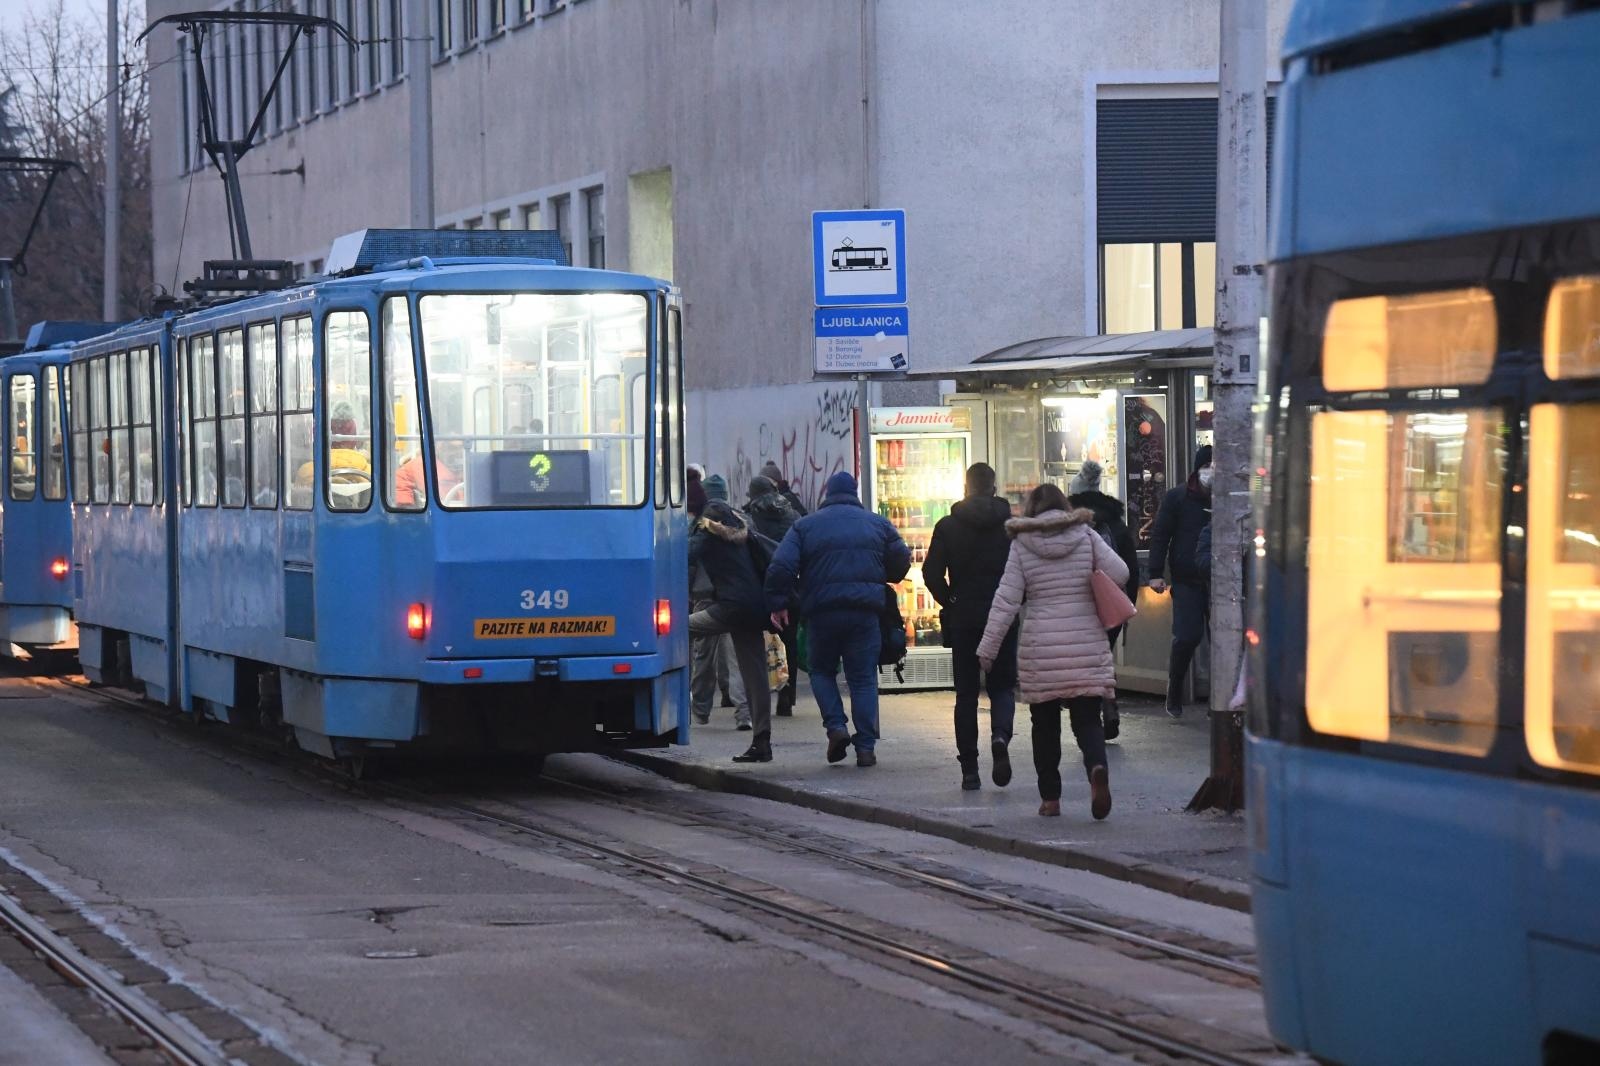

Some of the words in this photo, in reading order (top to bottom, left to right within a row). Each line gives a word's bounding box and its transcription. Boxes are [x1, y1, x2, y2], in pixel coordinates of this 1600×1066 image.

[821, 316, 902, 328] LJUBLJANICA
[886, 412, 954, 426] Jamnica
[520, 589, 569, 610] 349
[480, 622, 525, 635] PAZITE
[528, 622, 545, 634] NA
[550, 620, 608, 634] RAZMAK!
